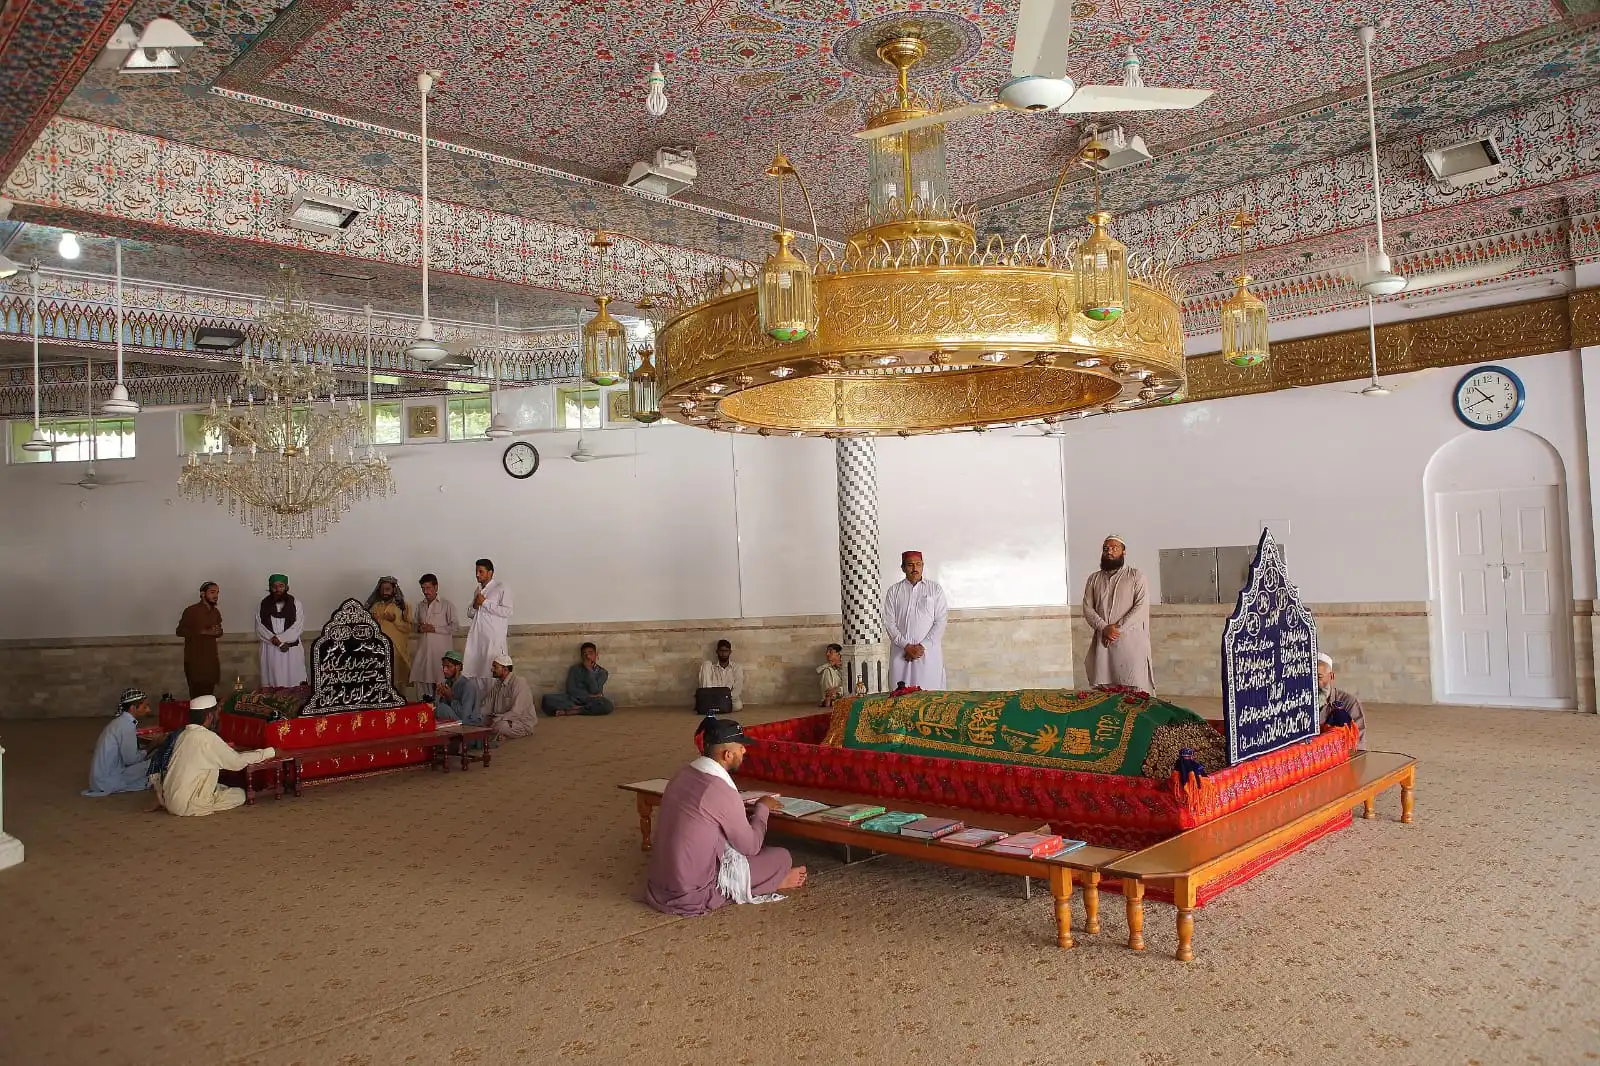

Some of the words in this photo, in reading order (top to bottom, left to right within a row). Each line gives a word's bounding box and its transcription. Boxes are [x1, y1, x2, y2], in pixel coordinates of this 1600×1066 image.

[1483, 376, 1492, 384] 12
[1497, 376, 1500, 384] 1
[1504, 382, 1510, 390] 2
[1464, 396, 1470, 404] 9
[1507, 392, 1513, 400] 3
